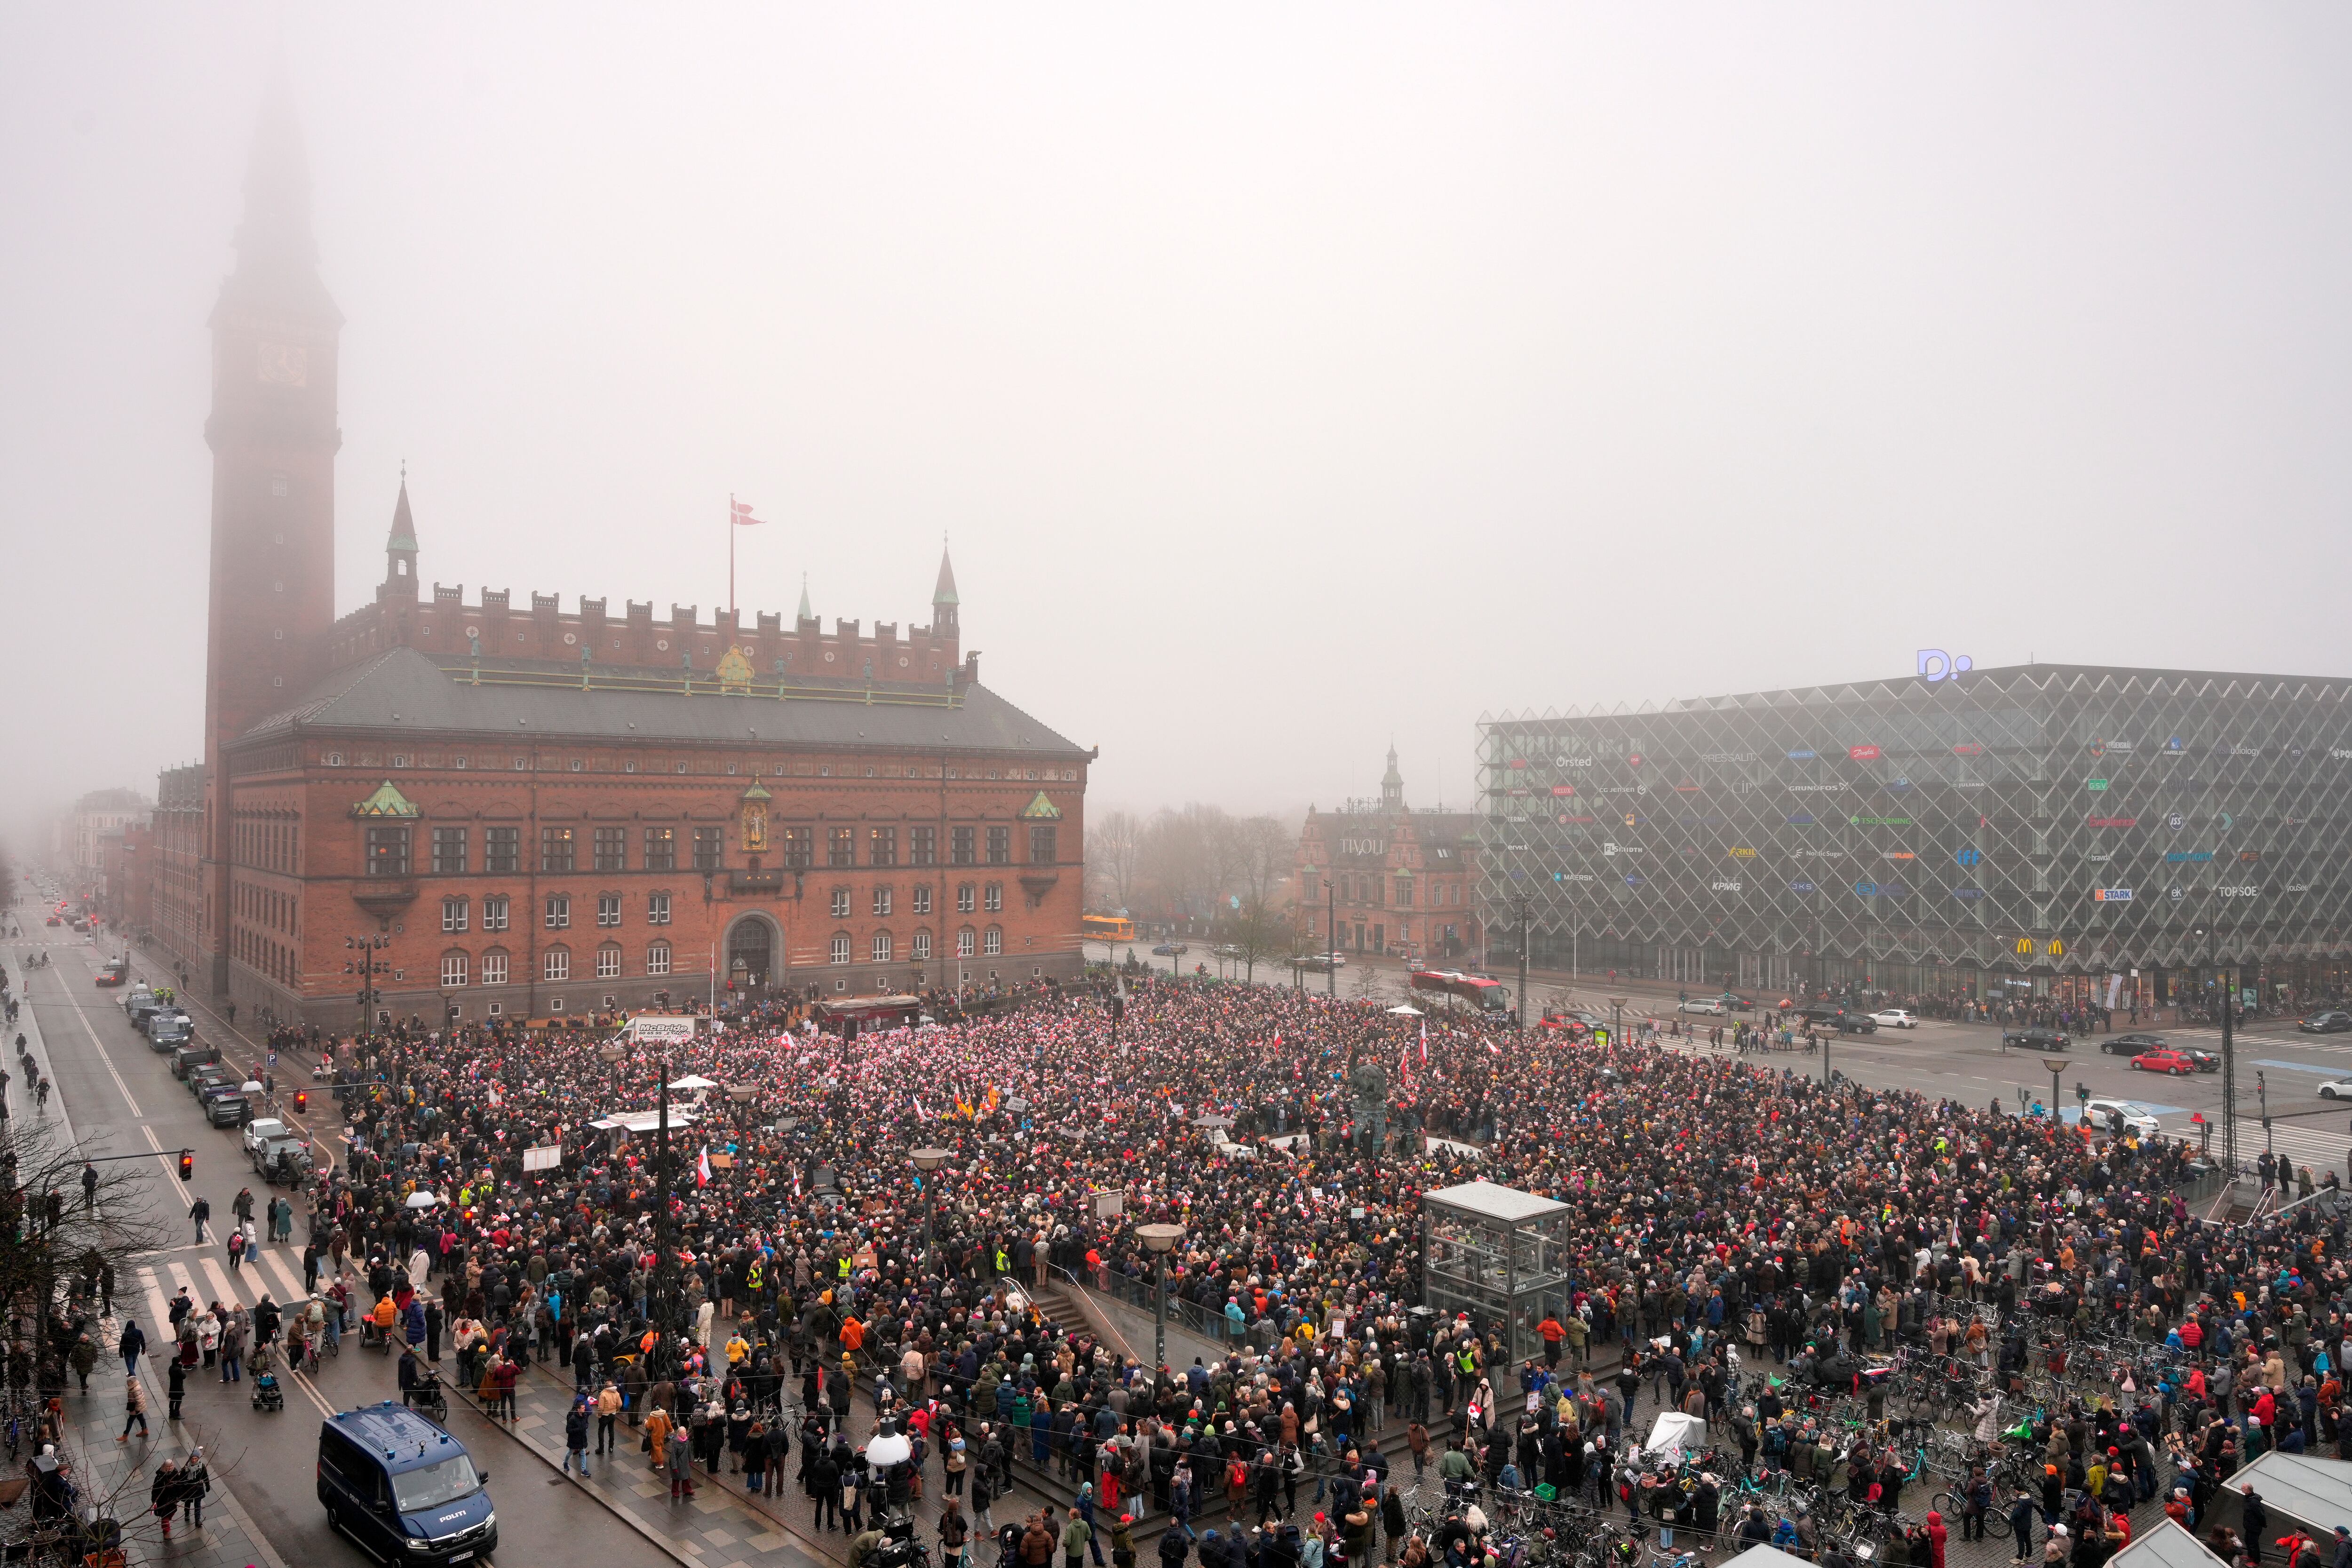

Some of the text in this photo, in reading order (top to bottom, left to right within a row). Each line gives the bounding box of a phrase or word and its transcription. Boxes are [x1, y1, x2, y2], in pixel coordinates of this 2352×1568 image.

[1853, 748, 1874, 757] Danfoss
[1556, 755, 1591, 767] Ørsted
[1340, 839, 1383, 855] TIVOLI
[1728, 846, 1757, 857] ARKIL
[2104, 890, 2130, 899] STARK
[2171, 886, 2182, 897] ek
[2219, 886, 2257, 897] TOPSOE
[349, 1493, 359, 1506] POLITI
[439, 1510, 467, 1523] POLITI
